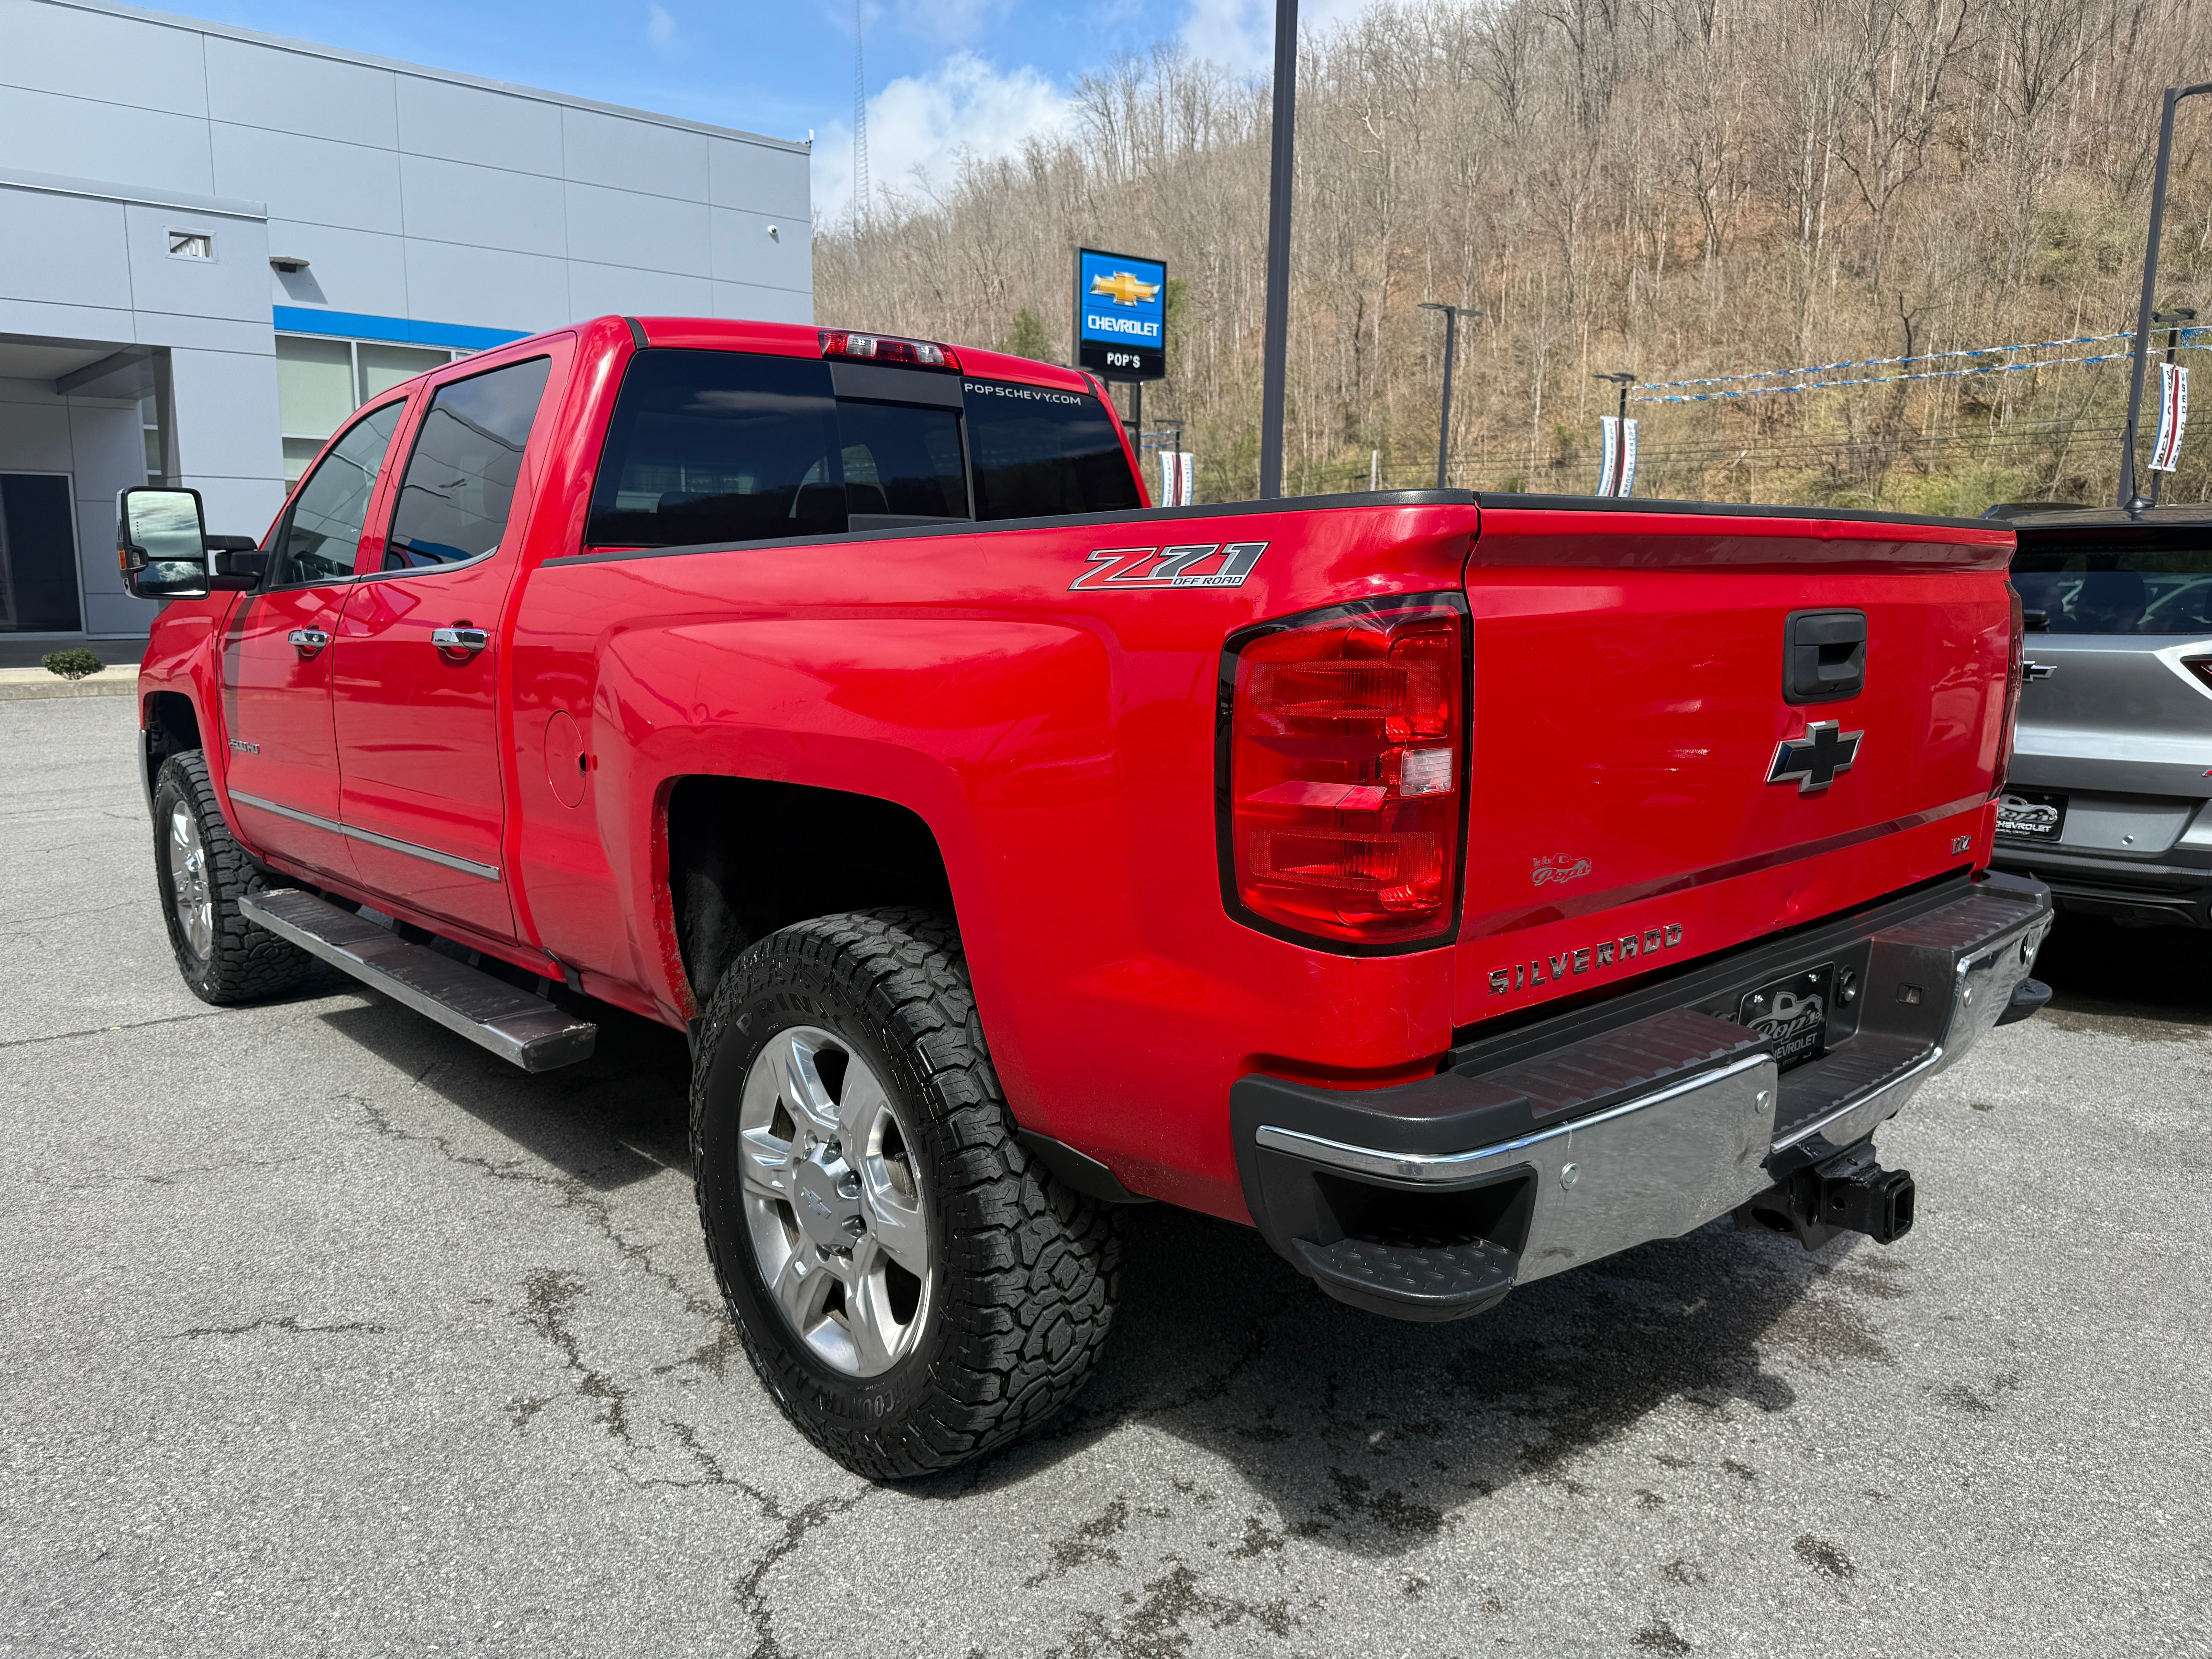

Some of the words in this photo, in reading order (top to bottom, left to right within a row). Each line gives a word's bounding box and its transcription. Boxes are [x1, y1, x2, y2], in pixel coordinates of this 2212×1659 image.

[1088, 315, 1159, 337] CHEVROLET
[1107, 352, 1140, 368] POP'S
[964, 383, 1081, 405] POPSCHEVY.COM
[1066, 540, 1272, 591] Z71
[1202, 576, 1243, 585] ROAD
[1487, 922, 1682, 996] SILVERADO
